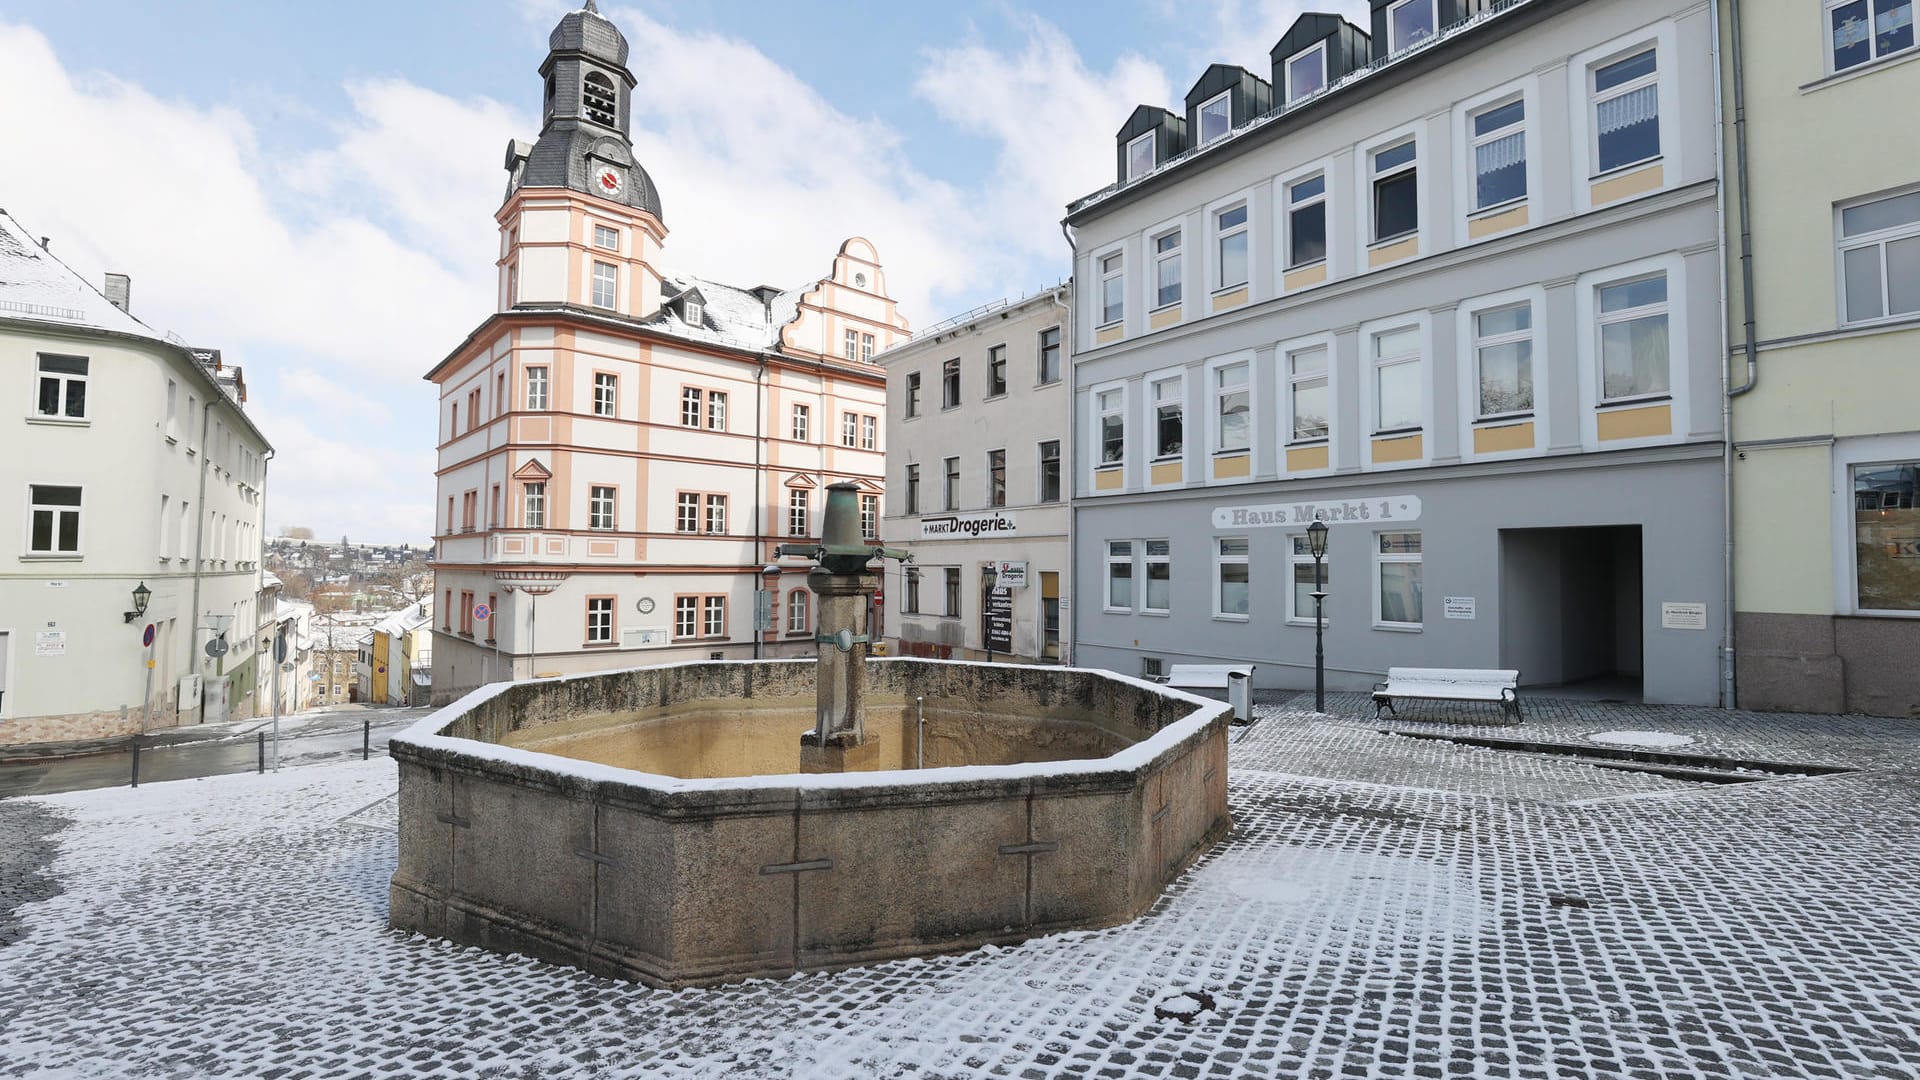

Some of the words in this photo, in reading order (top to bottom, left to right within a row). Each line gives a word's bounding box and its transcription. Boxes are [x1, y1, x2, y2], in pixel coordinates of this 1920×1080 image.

[928, 523, 949, 534] MARKT
[949, 512, 1009, 536] Drogerie
[1231, 508, 1287, 525] Haus
[1293, 502, 1370, 523] Markt
[1379, 501, 1393, 519] 1
[1001, 572, 1024, 580] Drogerie
